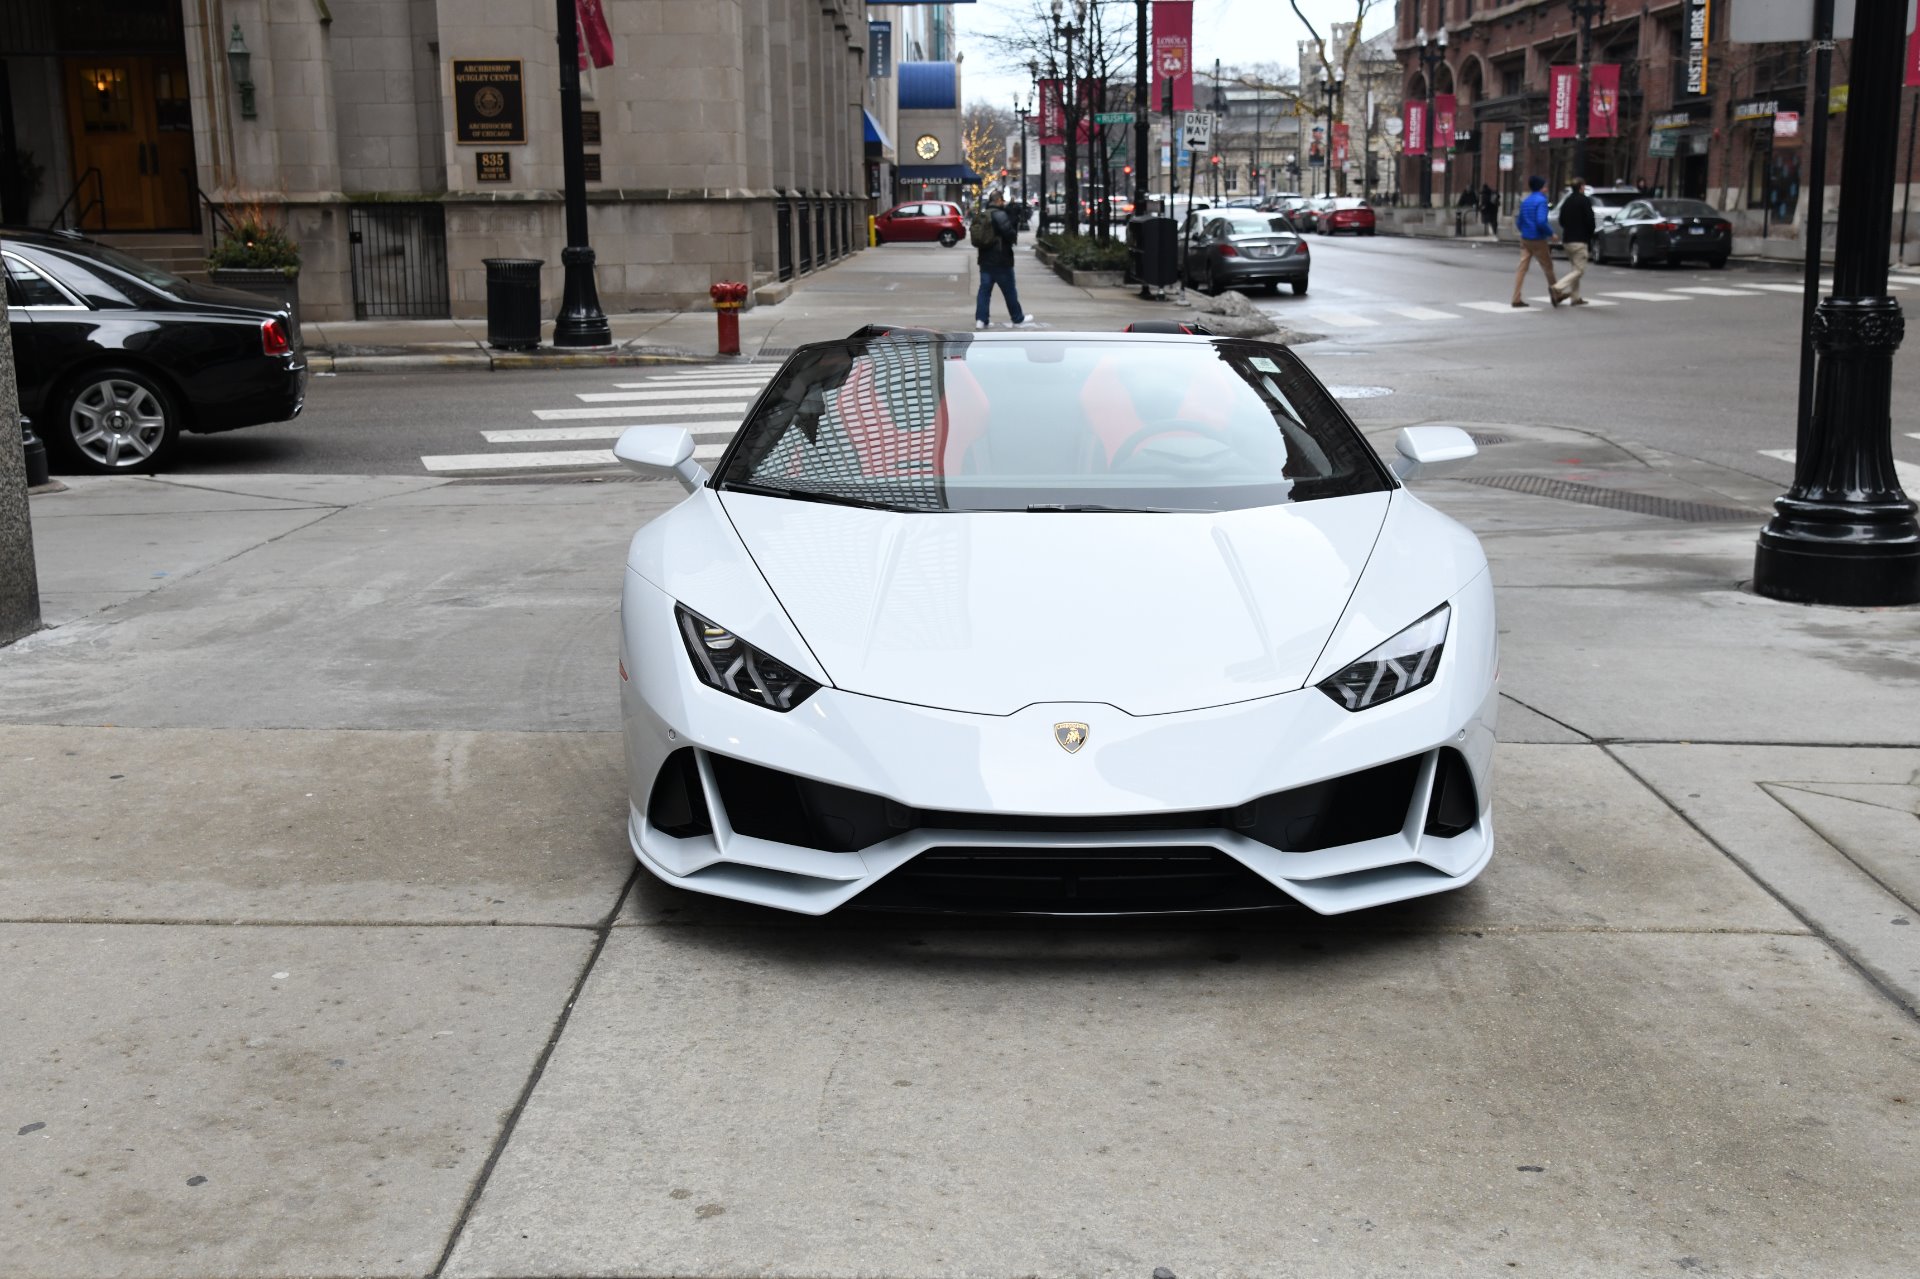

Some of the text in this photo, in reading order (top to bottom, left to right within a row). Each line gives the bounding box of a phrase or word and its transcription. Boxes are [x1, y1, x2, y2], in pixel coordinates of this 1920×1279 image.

[1691, 8, 1706, 39] BROS.
[1156, 37, 1188, 45] LOYOLA
[463, 64, 511, 73] ARCHBISHOP
[1687, 41, 1703, 93] EINSTEIN
[456, 73, 519, 82] QUIGLEY CENTER
[1555, 74, 1566, 129] WELCOME
[1186, 114, 1209, 126] ONE
[1185, 126, 1209, 136] WAY
[481, 153, 504, 165] 835
[899, 177, 963, 185] GHIRARDELLI
